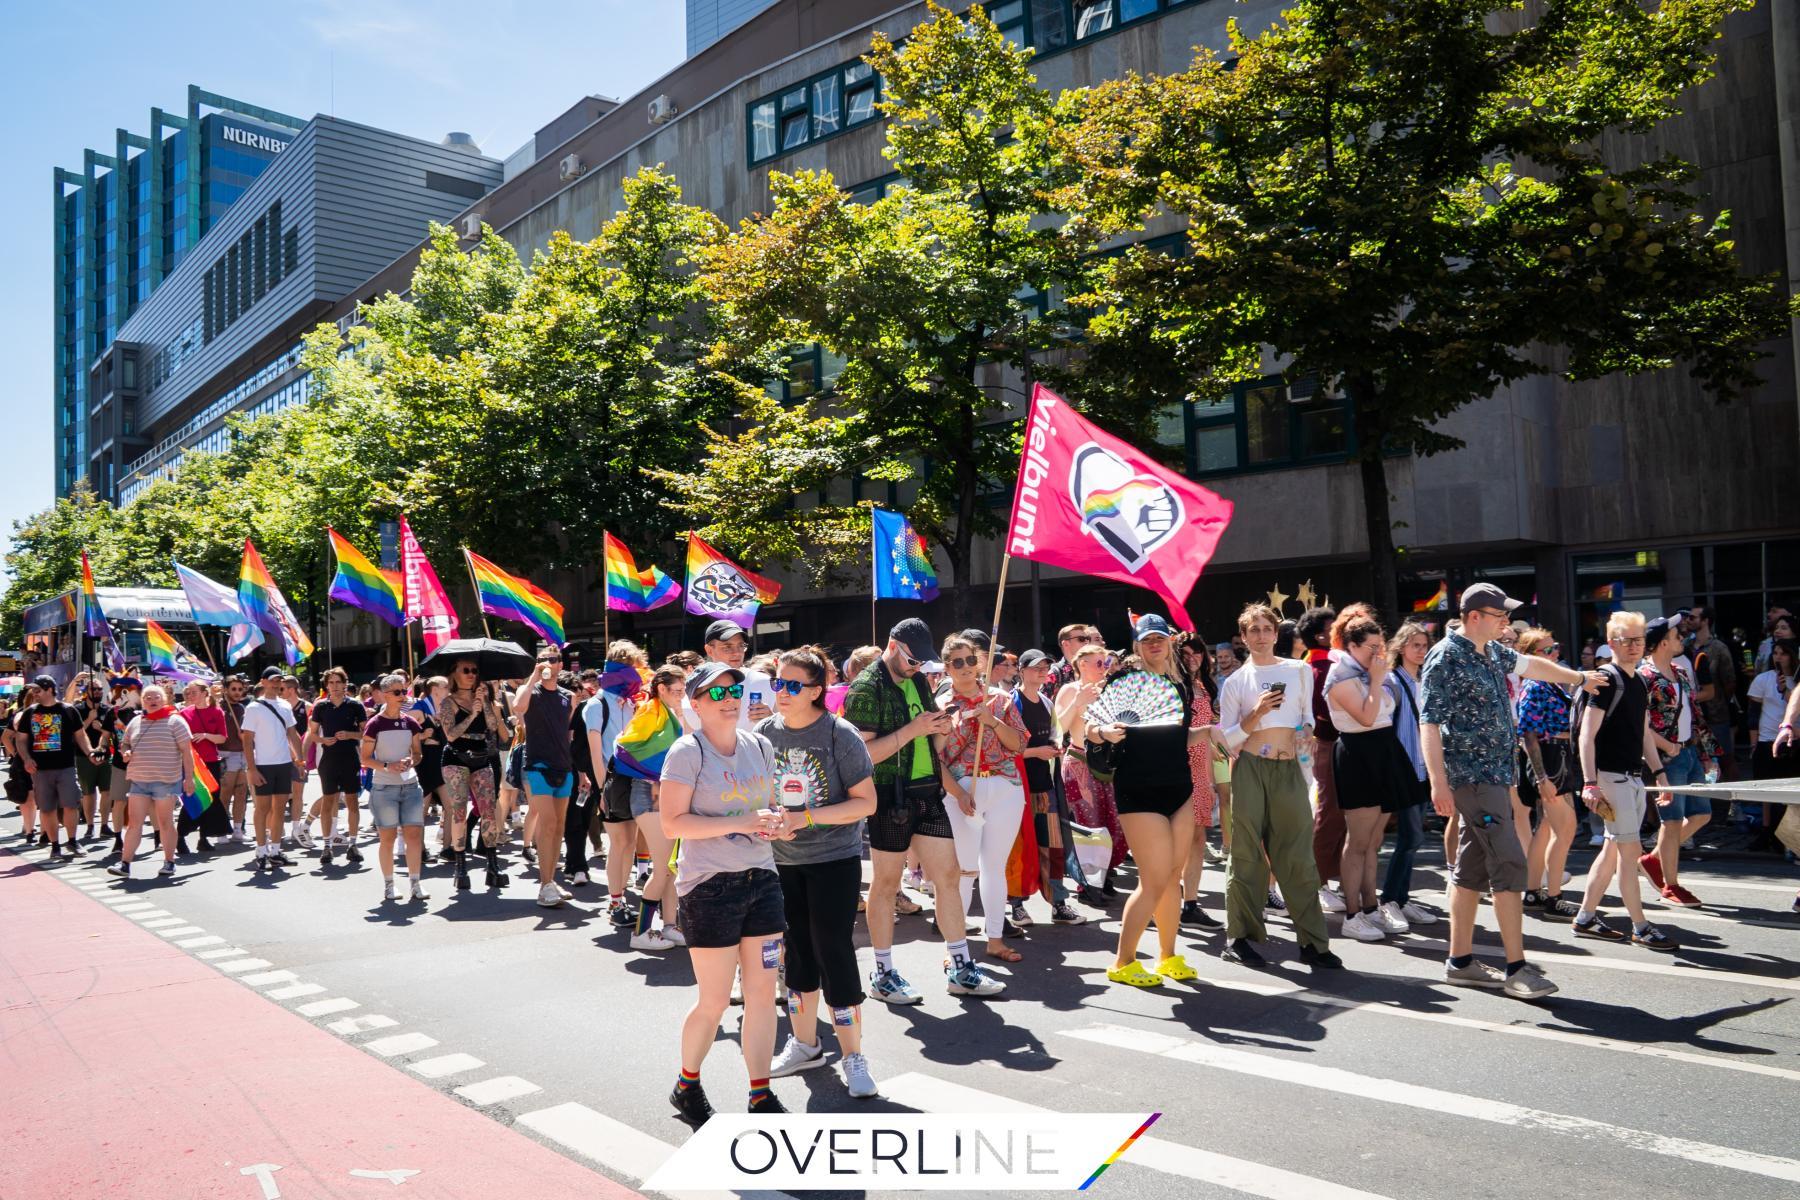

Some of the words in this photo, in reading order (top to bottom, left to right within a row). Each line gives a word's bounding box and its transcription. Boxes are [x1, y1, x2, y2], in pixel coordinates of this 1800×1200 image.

[1011, 399, 1058, 556] vielbunt
[126, 607, 192, 619] CharterWa
[876, 961, 885, 975] B
[953, 954, 965, 969] B
